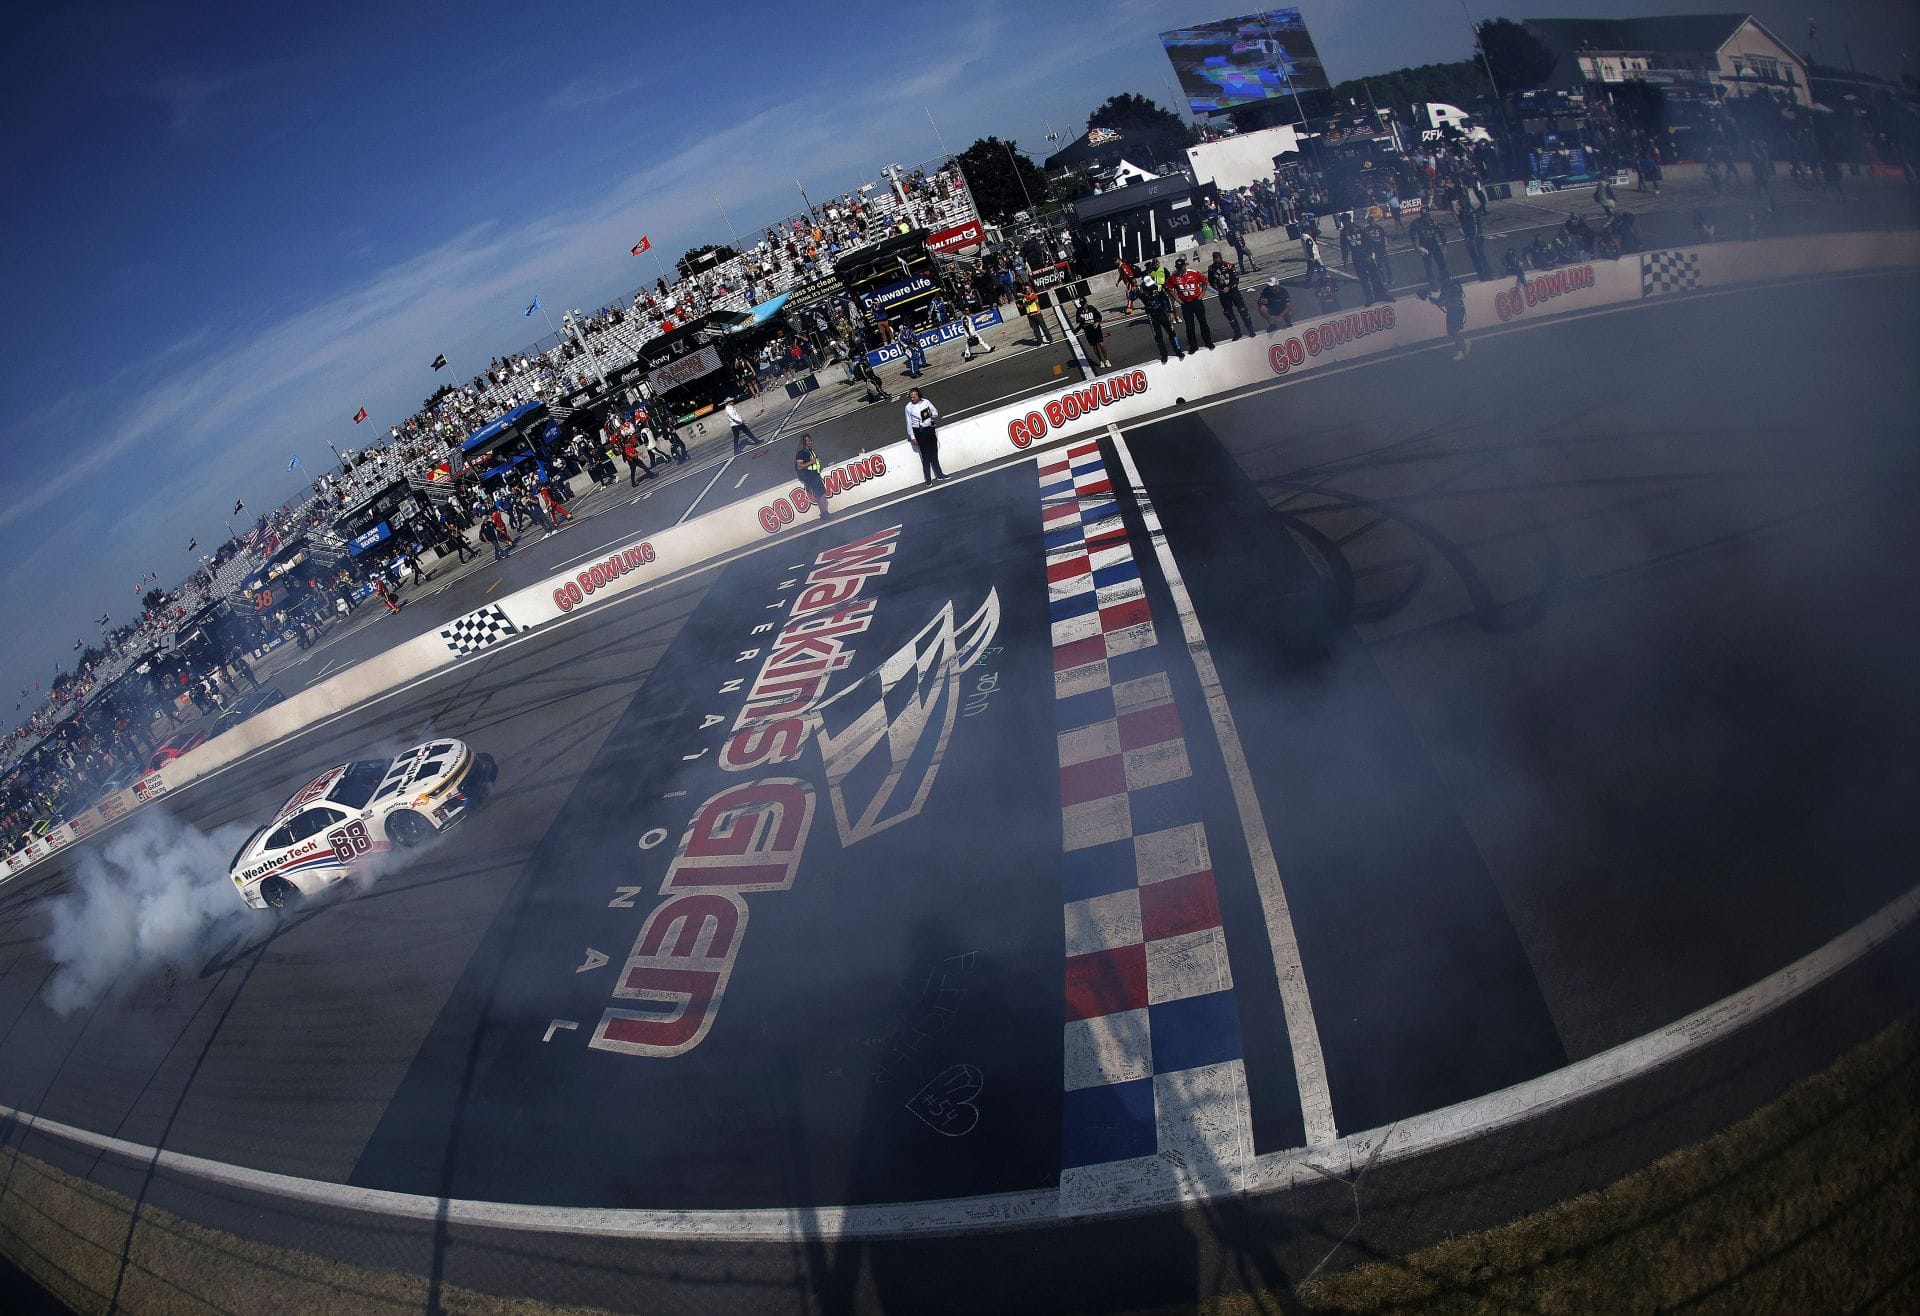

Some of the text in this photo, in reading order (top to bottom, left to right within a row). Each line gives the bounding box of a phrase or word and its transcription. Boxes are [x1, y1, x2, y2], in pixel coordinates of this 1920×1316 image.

[945, 235, 963, 247] TIRE
[787, 276, 837, 301] Glass so clean
[911, 278, 931, 291] Life
[1495, 265, 1595, 321] GO BOWLING
[941, 321, 965, 341] Life
[1268, 305, 1395, 375] GO BOWLING
[1008, 370, 1148, 448] GO BOWLING
[758, 499, 794, 533] GO
[552, 542, 656, 612] GO BOWLING
[254, 590, 273, 611] 38
[160, 633, 176, 655] 9
[137, 789, 152, 801] GR
[327, 819, 374, 864] 88
[242, 841, 317, 880] WeatherTech
